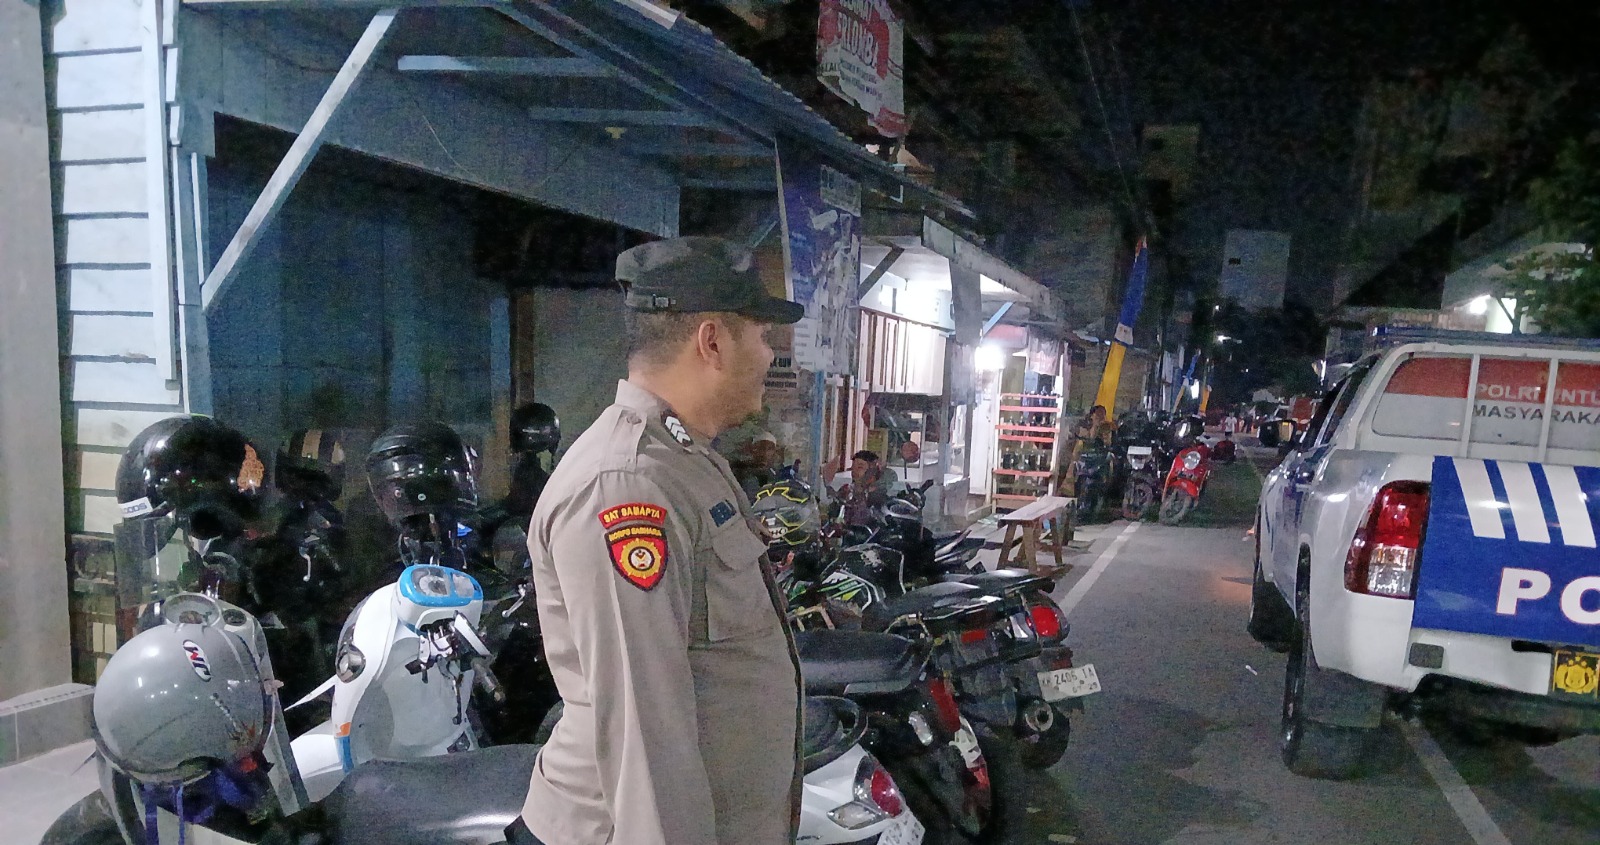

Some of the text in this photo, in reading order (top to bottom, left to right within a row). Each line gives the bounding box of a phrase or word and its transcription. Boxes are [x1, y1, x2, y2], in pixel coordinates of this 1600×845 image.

[1477, 383, 1540, 401] POLRI
[603, 506, 660, 523] SAT SAMAPTA
[1054, 670, 1077, 685] 2406
